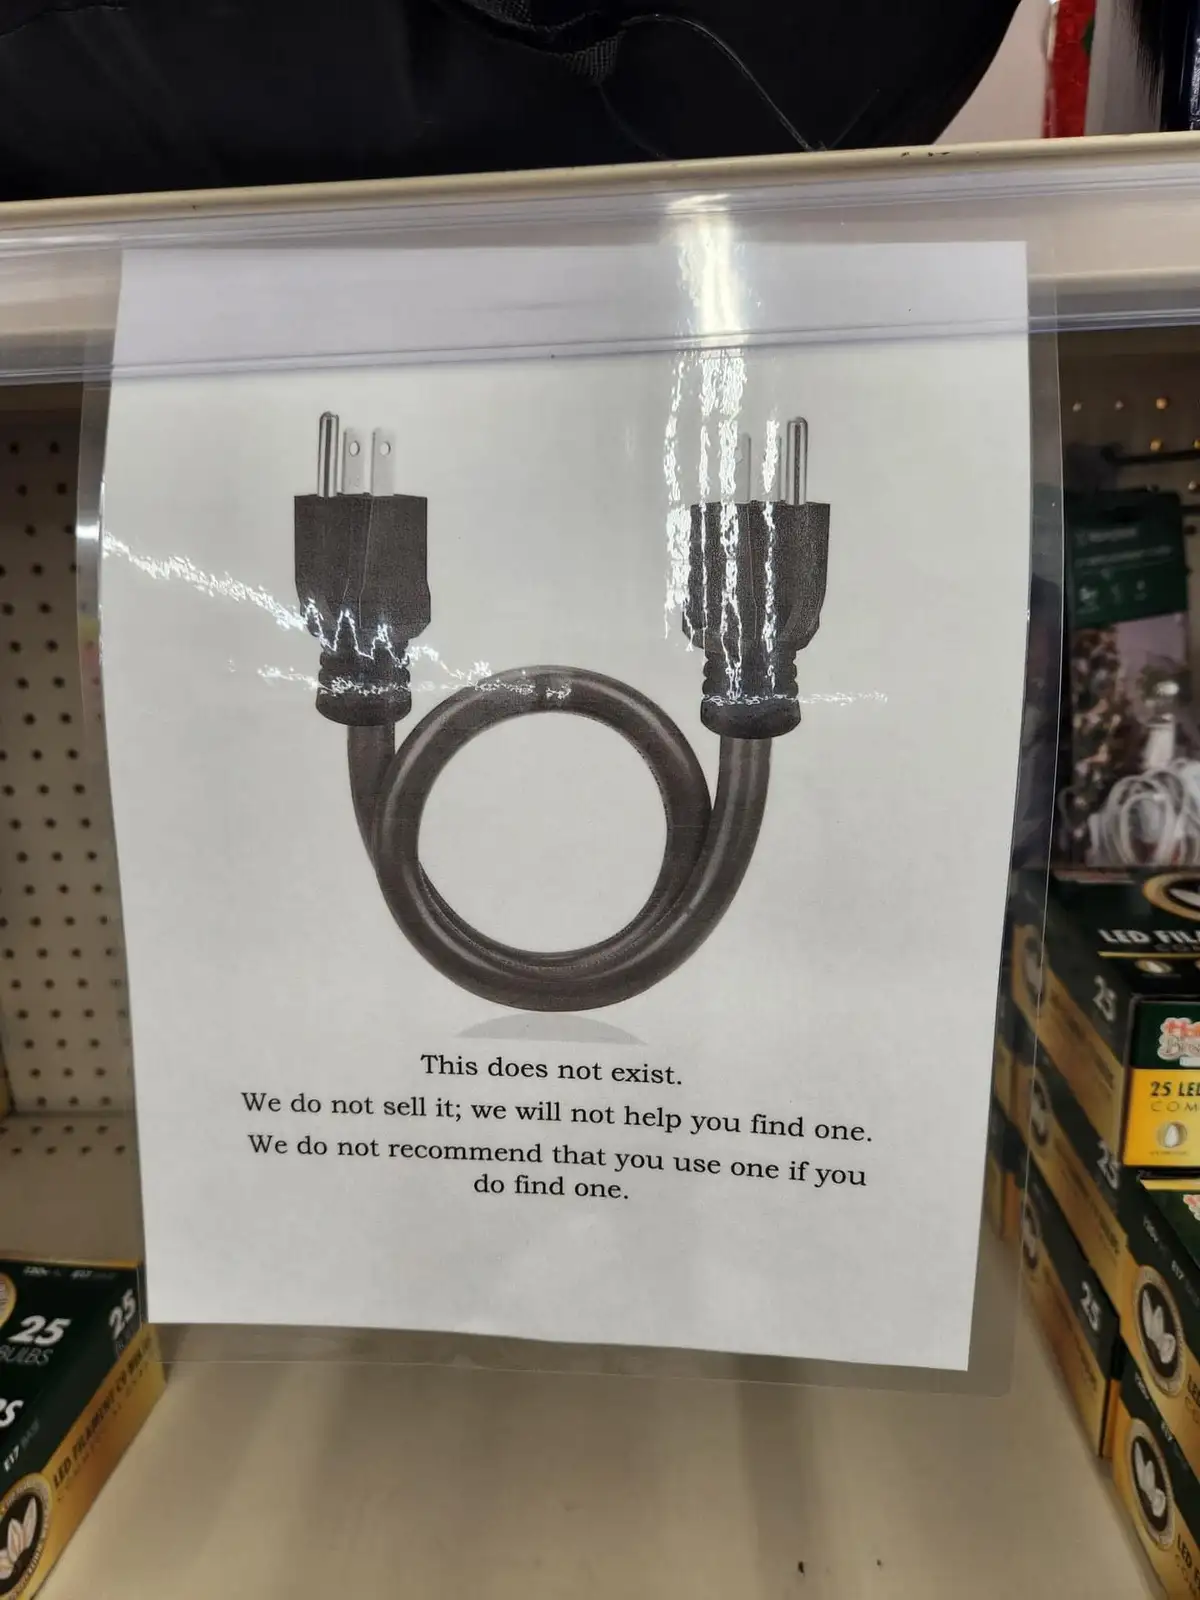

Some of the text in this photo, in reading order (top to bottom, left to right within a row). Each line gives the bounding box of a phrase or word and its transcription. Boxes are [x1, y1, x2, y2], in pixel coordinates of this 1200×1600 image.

[1098, 928, 1151, 944] LED
[420, 1054, 681, 1085] This does not exist.
[1150, 1080, 1172, 1097] 25
[241, 1092, 872, 1142] We do not sell it; we will not help you find one.
[248, 1134, 866, 1188] We do not recommend that you use one if you
[474, 1173, 628, 1199] do find one.
[7, 1314, 72, 1347] 25
[108, 1289, 136, 1340] 25
